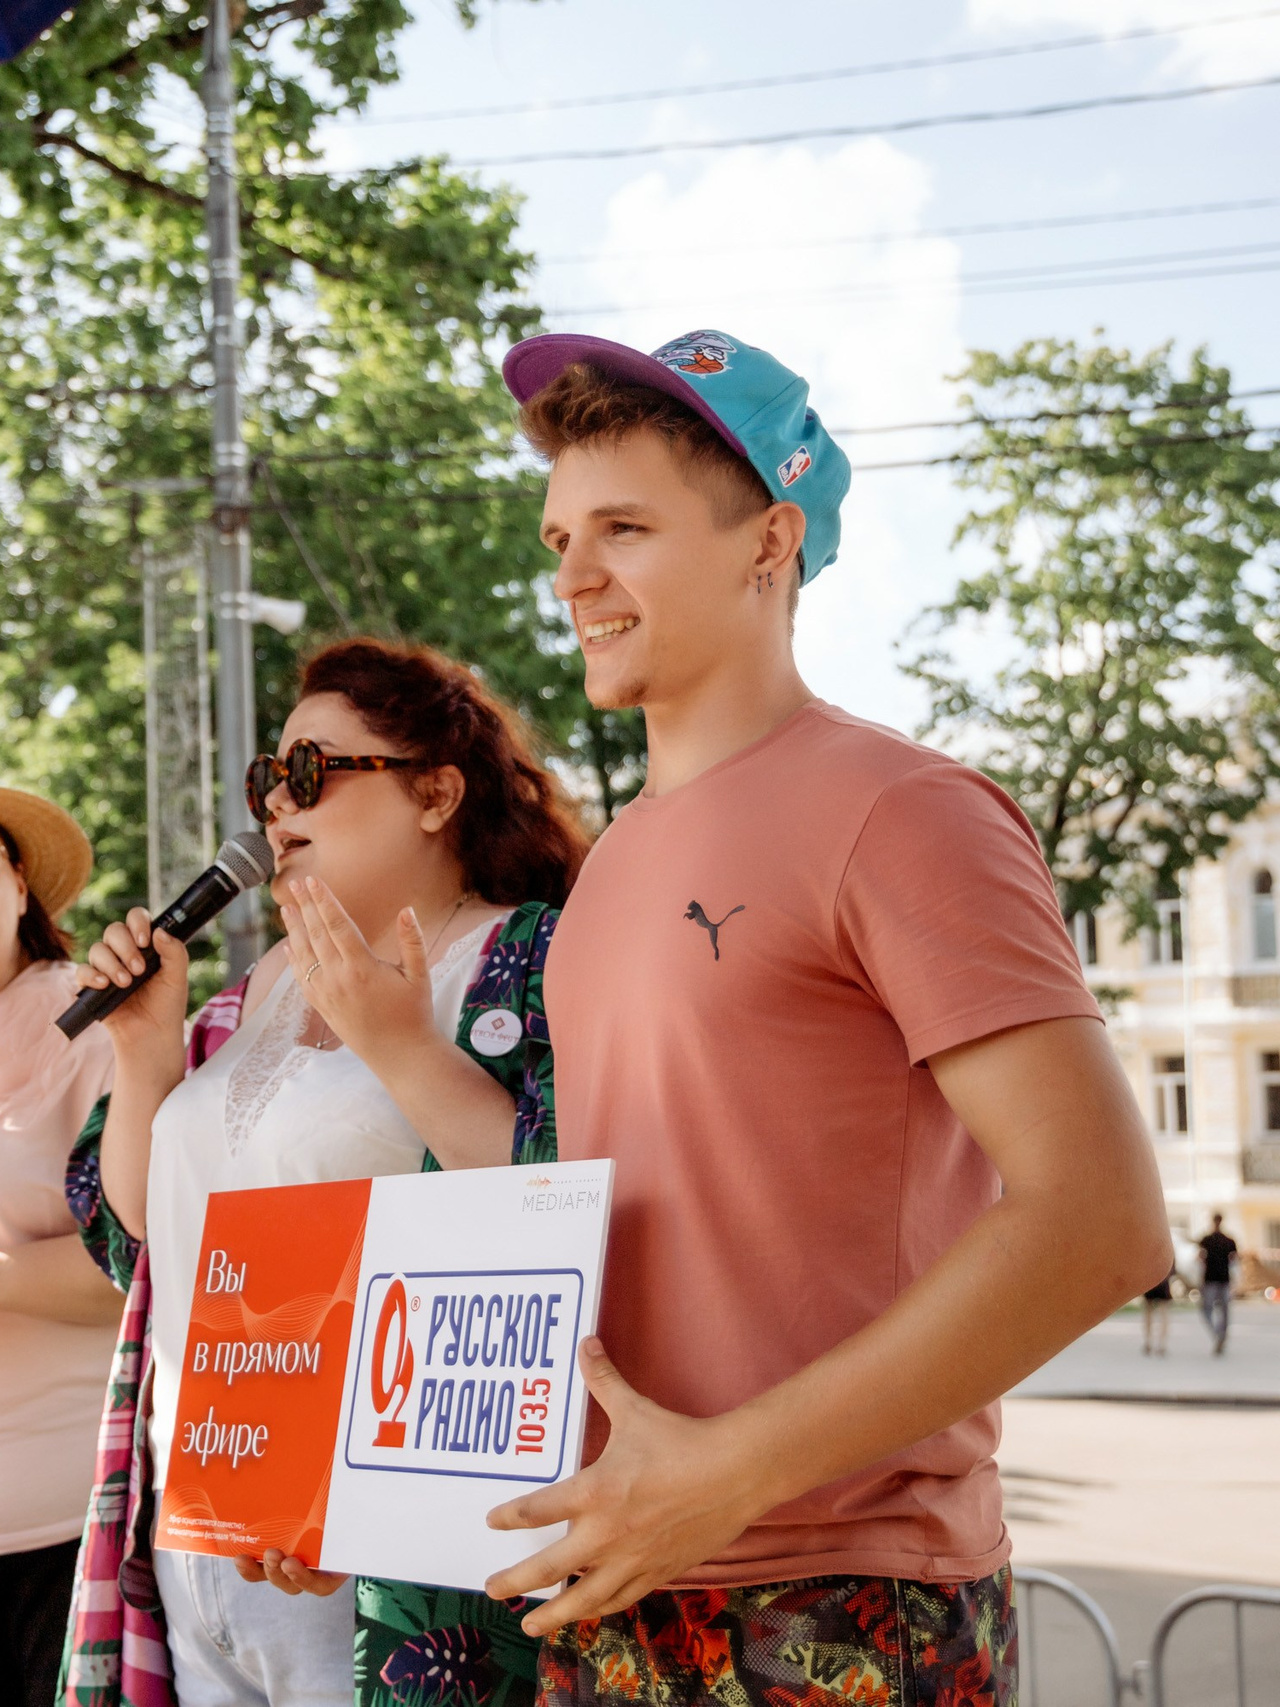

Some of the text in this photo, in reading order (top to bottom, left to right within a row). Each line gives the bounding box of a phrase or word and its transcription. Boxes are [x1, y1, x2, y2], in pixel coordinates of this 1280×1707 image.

[522, 1190, 600, 1212] MEDIAFM
[205, 1249, 246, 1293] Вы
[425, 1292, 562, 1369] РУССКОЕ
[193, 1341, 321, 1386] в прямом
[181, 1406, 268, 1469] эфире
[415, 1377, 515, 1455] РАДИО
[515, 1378, 551, 1456] 103.5
